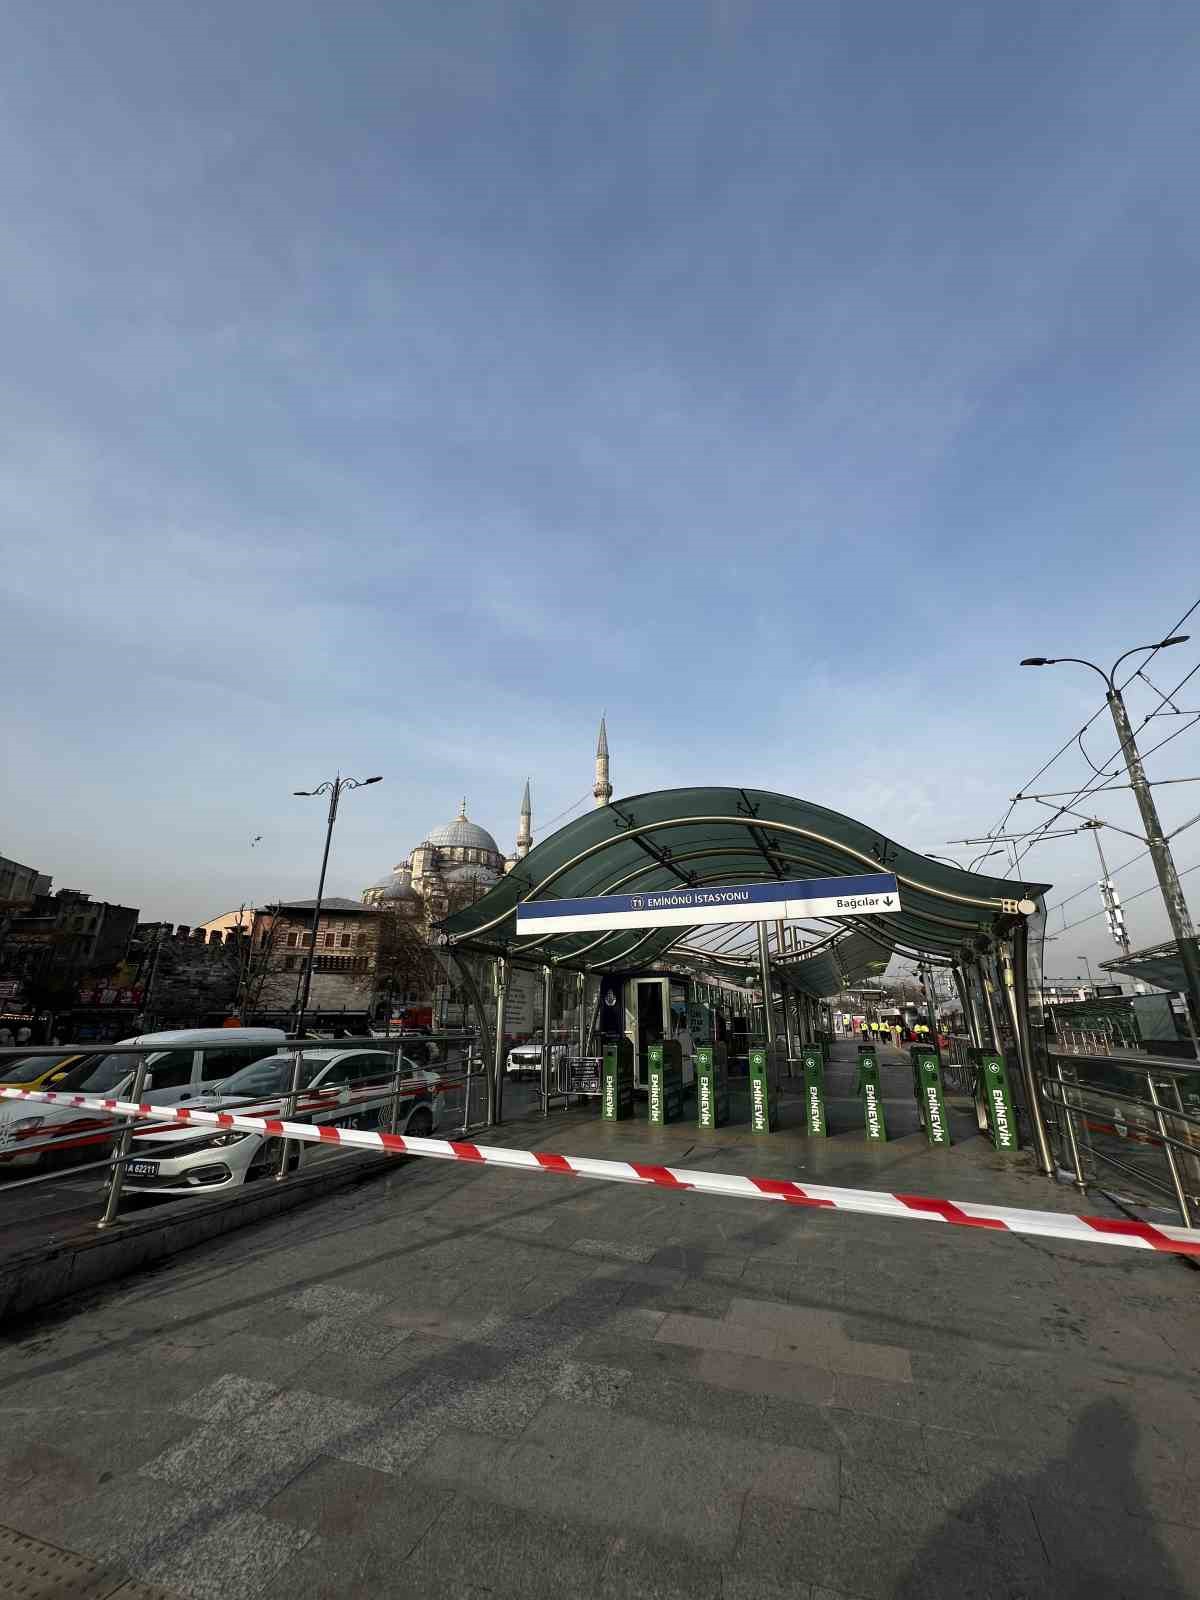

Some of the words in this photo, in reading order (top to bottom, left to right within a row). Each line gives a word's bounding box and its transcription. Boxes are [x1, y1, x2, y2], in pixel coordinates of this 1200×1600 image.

[648, 895, 692, 907] EMİNÖNÜ
[694, 891, 749, 904] İSTASYONU
[836, 897, 879, 909] Bağcılar
[700, 1076, 711, 1125] EMİNEVİM
[753, 1079, 765, 1130] EMİNEVİM
[809, 1086, 822, 1132] EMİNEVİM
[865, 1084, 881, 1137] EMİNEVİM
[926, 1087, 945, 1142] EMİNEVİM
[992, 1089, 1012, 1146] EMİNEVİM
